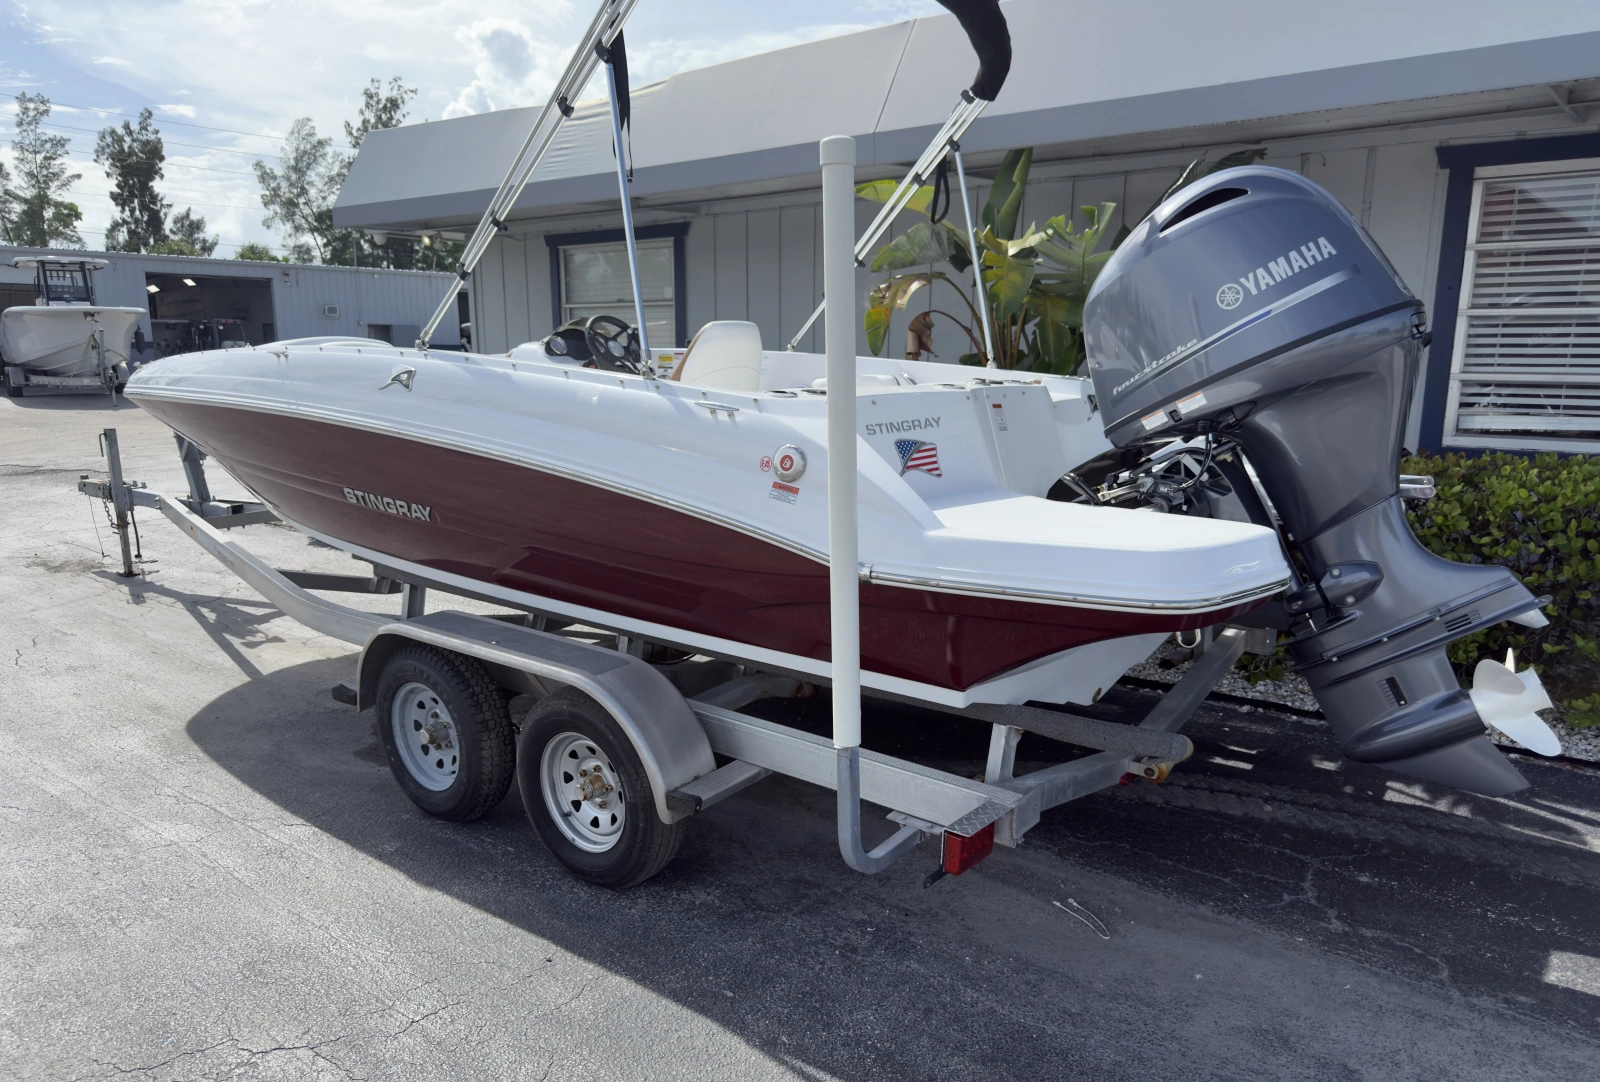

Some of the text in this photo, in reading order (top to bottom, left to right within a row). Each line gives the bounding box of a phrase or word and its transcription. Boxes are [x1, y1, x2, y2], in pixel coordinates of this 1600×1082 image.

[1239, 236, 1338, 296] YAMAHA
[865, 416, 942, 436] STINGRAY
[343, 487, 431, 522] STINGRAY
